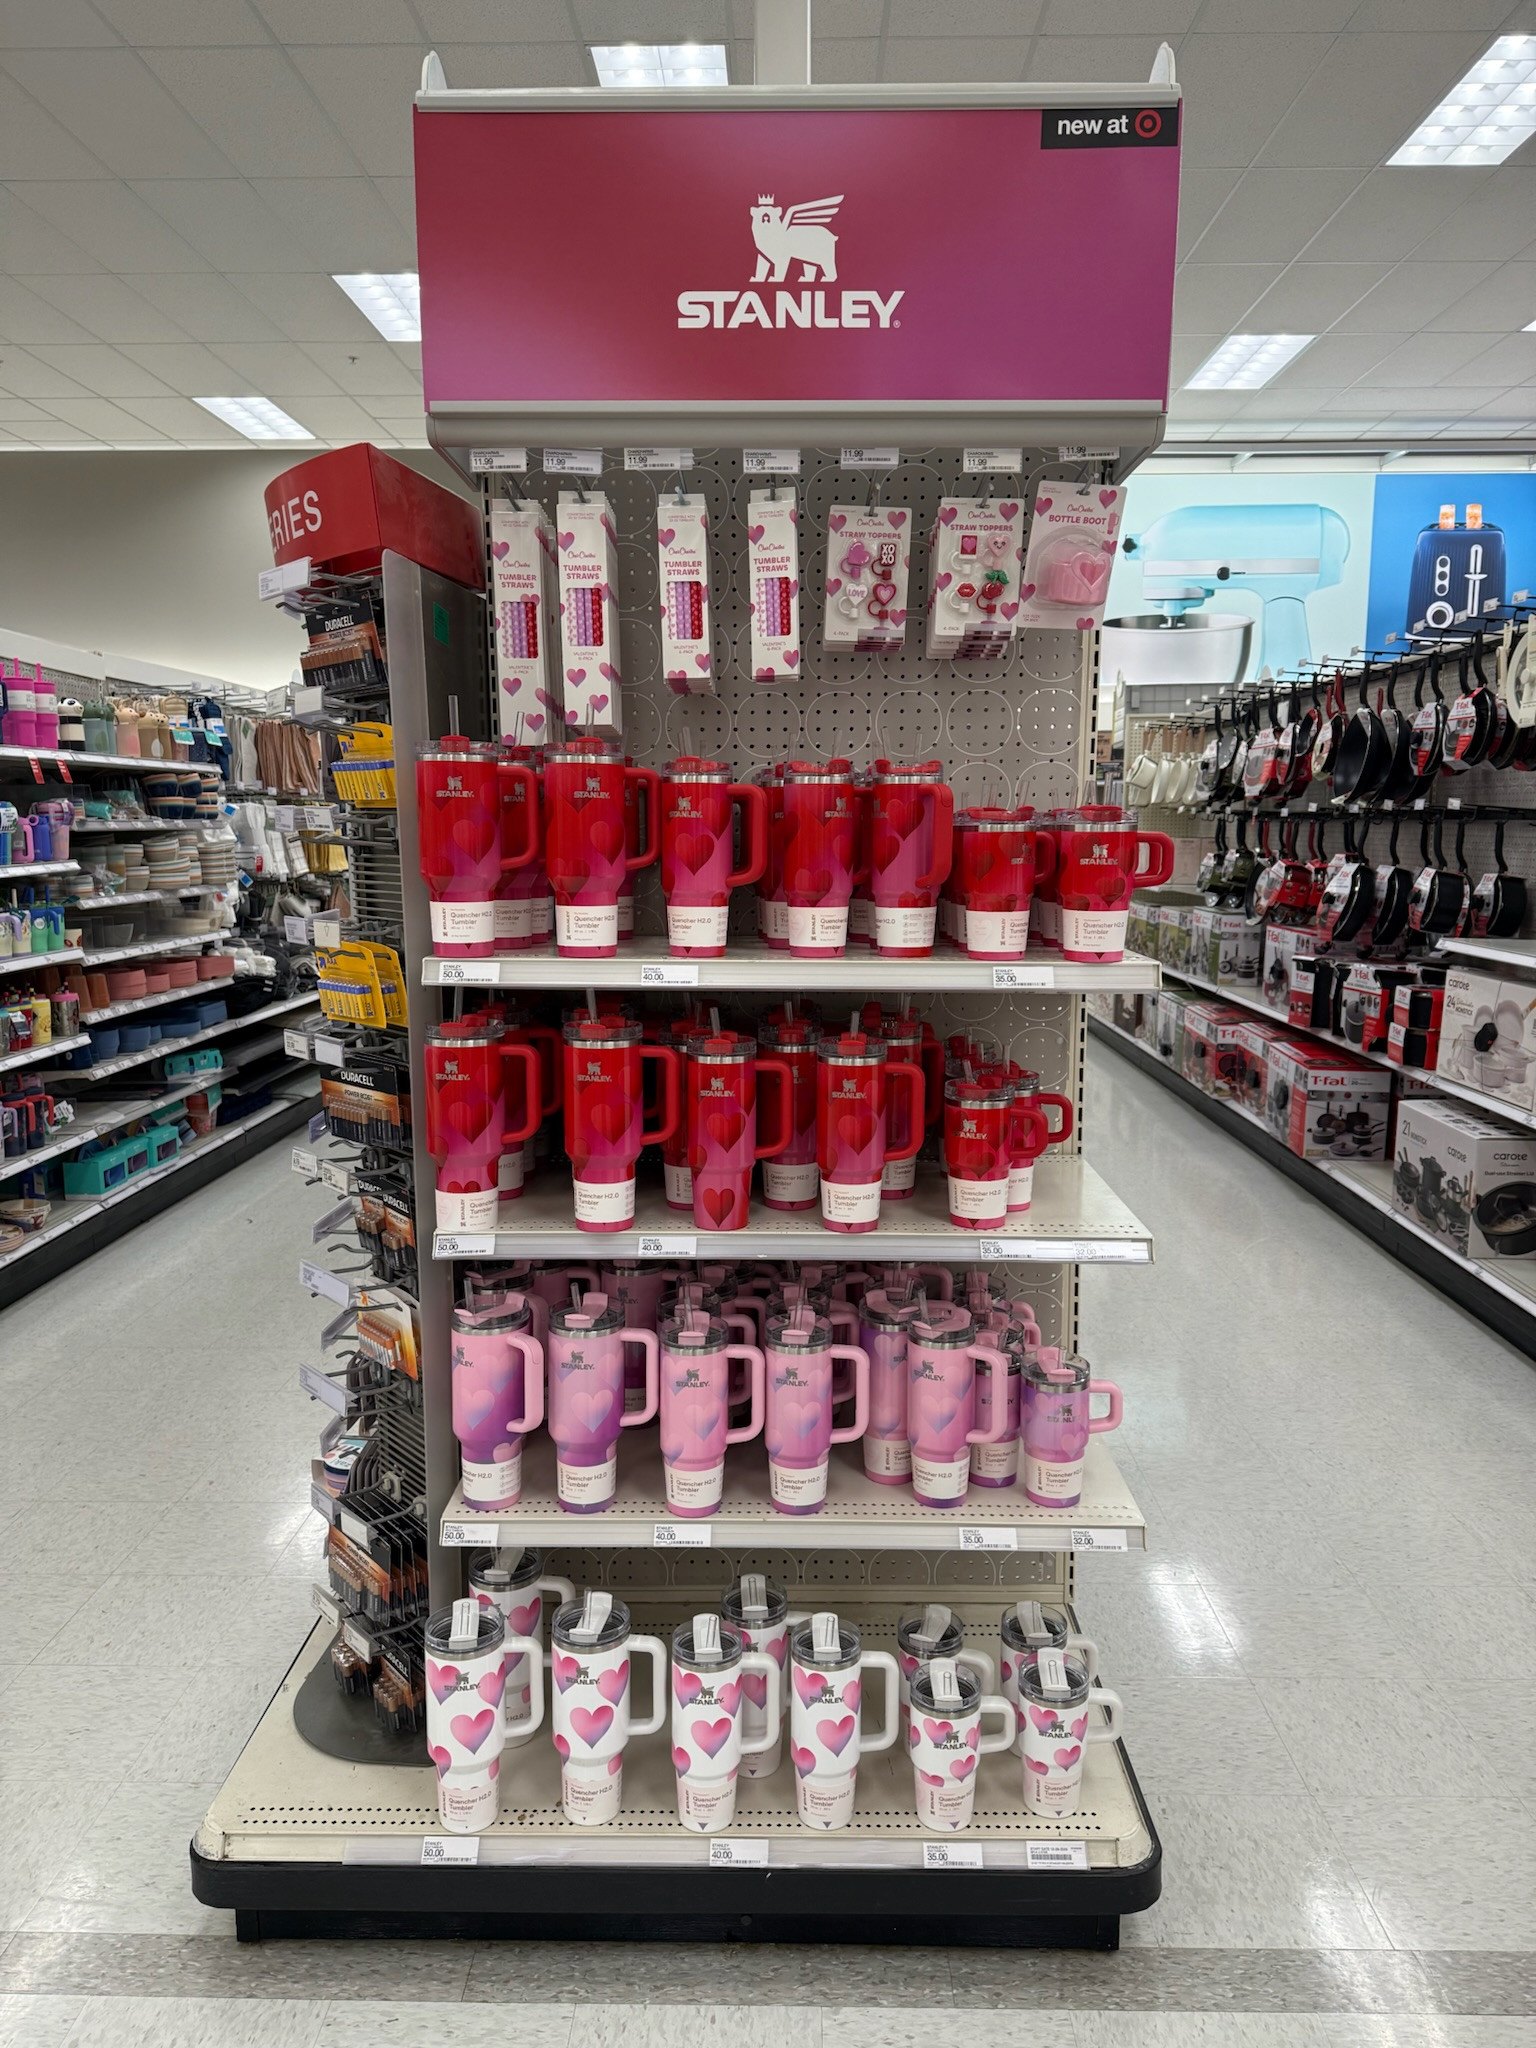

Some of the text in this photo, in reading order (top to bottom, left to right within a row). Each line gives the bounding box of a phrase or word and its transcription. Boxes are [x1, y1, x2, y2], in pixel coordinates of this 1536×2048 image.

[1057, 115, 1129, 136] new at
[677, 291, 904, 329] STANLEY
[1049, 515, 1107, 525] BOTTLE BOOT
[882, 544, 895, 553] XO
[754, 557, 790, 565] TUMBLER
[882, 555, 894, 564] XO
[848, 589, 865, 597] LOVE
[325, 615, 354, 631] DURACELL
[574, 915, 603, 923] Quencher
[672, 917, 696, 925] Quencher
[1083, 922, 1112, 930] Quencher
[1296, 973, 1309, 981] T-fal
[1355, 969, 1369, 981] T-fal
[1449, 979, 1469, 990] carote
[1447, 995, 1455, 1008] 24
[341, 1071, 374, 1087] DURACELL
[1311, 1076, 1345, 1085] T-fal
[1403, 1120, 1411, 1136] 21
[1448, 1146, 1466, 1162] carote
[383, 1194, 409, 1213] DURACELL
[913, 1371, 945, 1381] STANLEY
[566, 1473, 593, 1481] Quencher
[676, 1479, 703, 1487] Quencher
[677, 1485, 699, 1493] Tumbler
[444, 1682, 480, 1692] STANLEY
[810, 1696, 844, 1704] STANLEY
[570, 1787, 598, 1796] Quencher
[1045, 1784, 1071, 1792] Quencher
[449, 1796, 477, 1805] Quencher
[571, 1794, 594, 1802] Tumbler
[693, 1794, 720, 1802] Quencher
[810, 1793, 837, 1801] Quencher
[424, 1849, 444, 1857] 50.00
[712, 1851, 732, 1859] 40.00
[928, 1853, 948, 1861] 35.00
